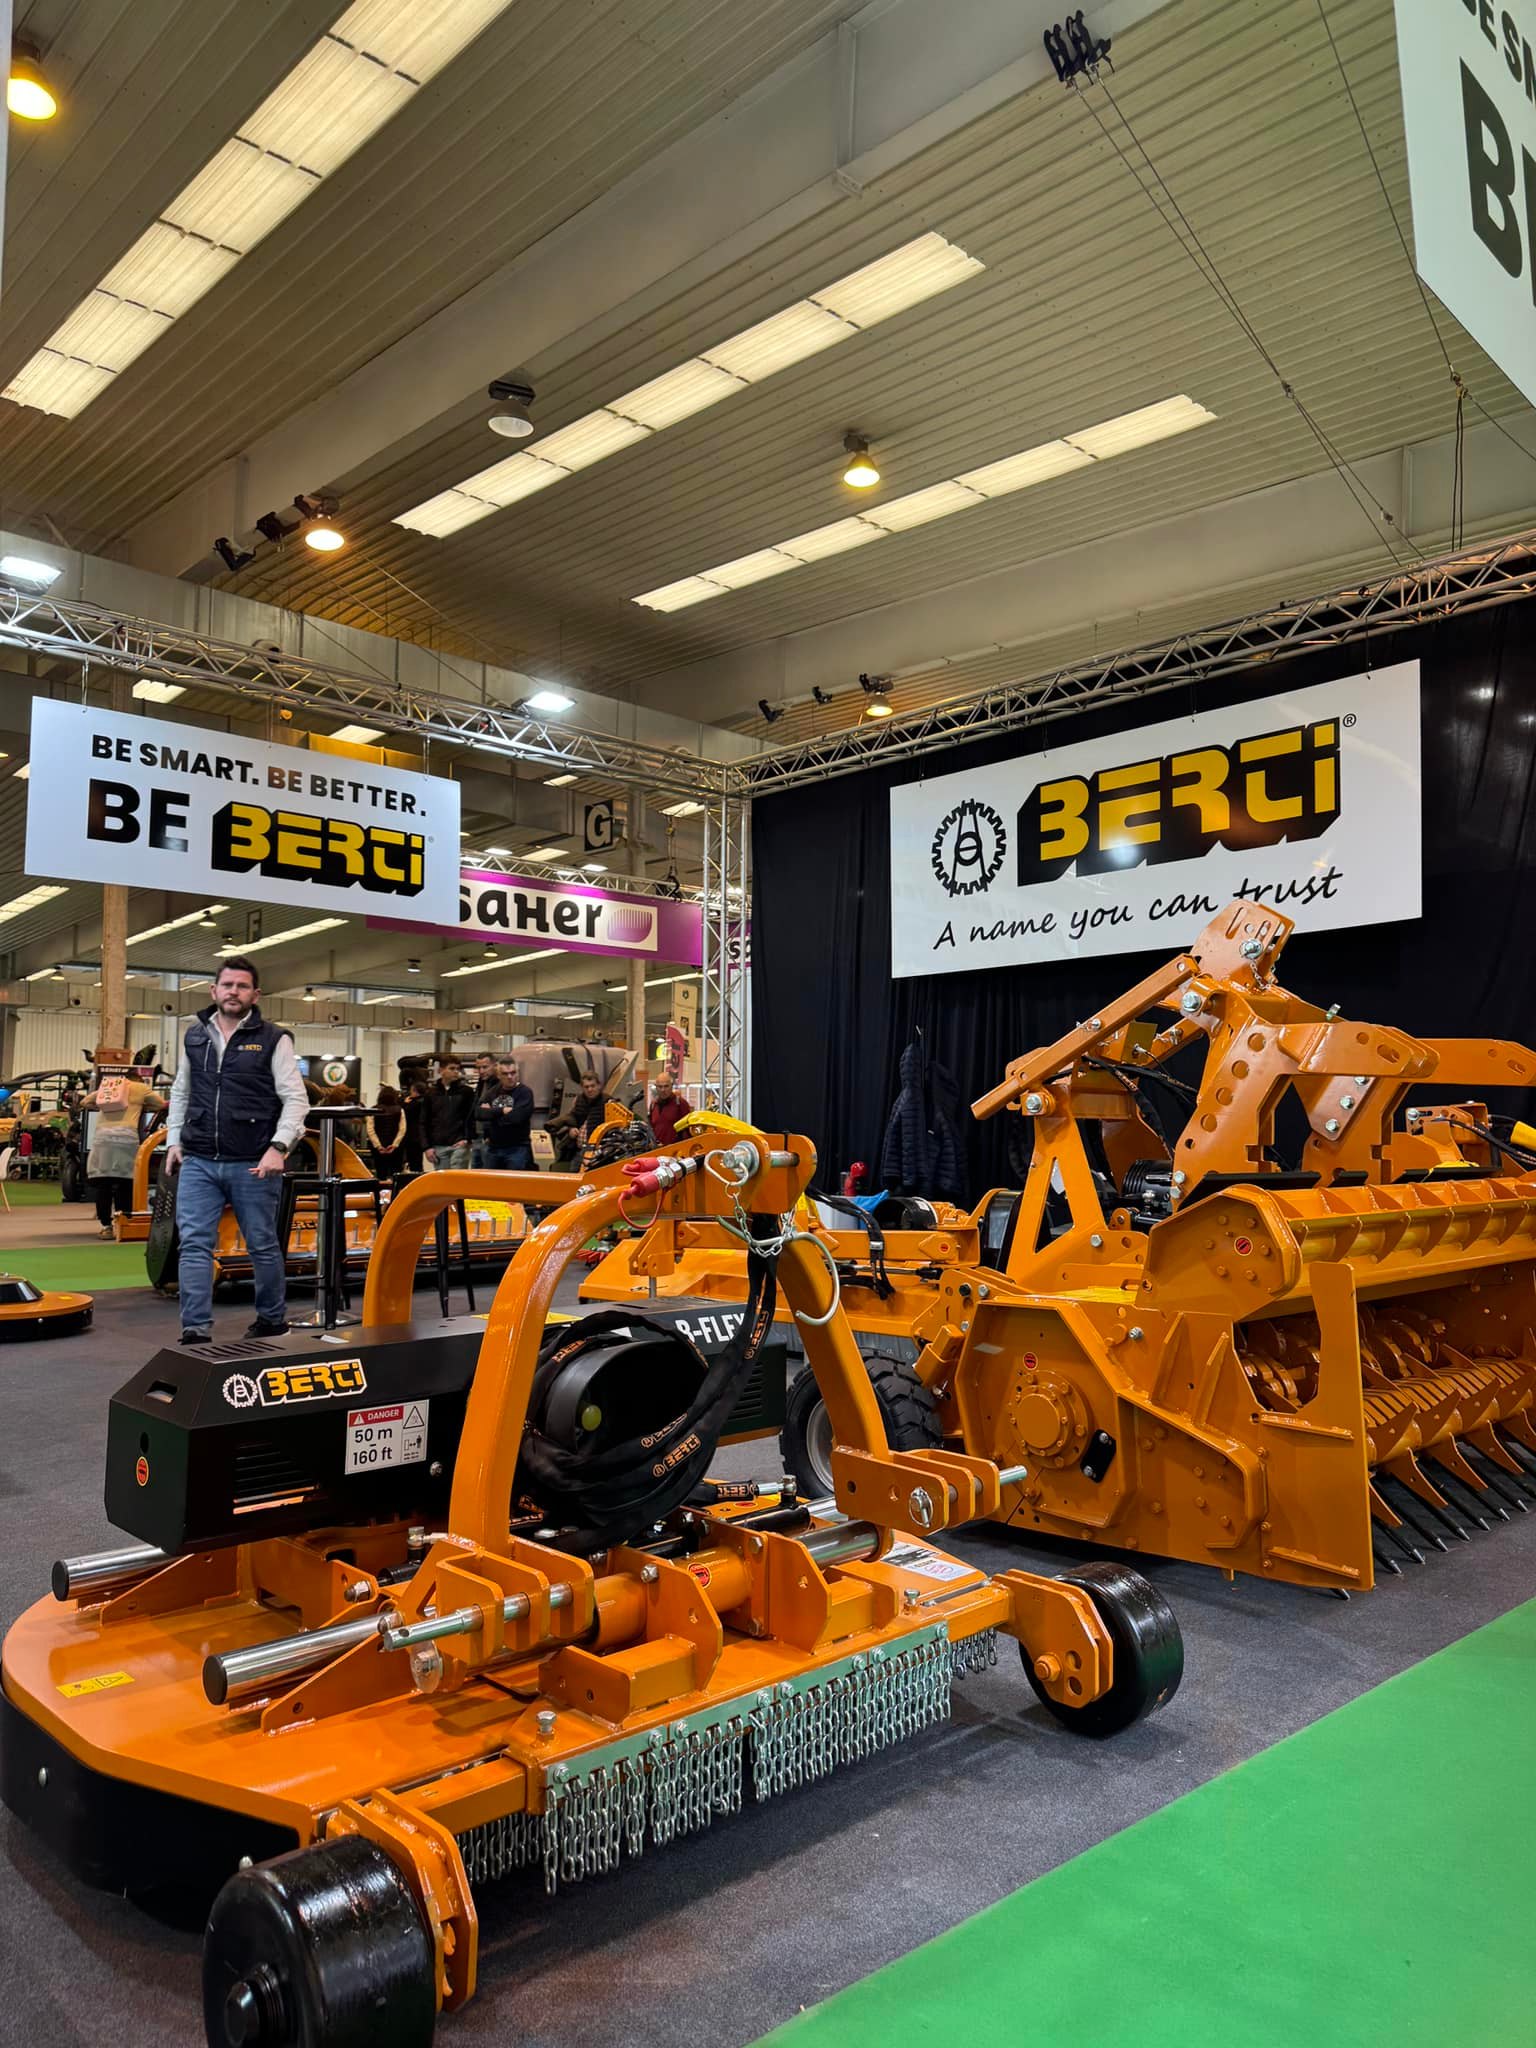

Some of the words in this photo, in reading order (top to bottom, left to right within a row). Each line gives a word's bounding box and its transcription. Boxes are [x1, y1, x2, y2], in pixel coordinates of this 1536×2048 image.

[1460, 56, 1536, 308] B
[92, 735, 132, 763] BE
[140, 743, 259, 785] SMART.
[268, 766, 303, 793] BE
[311, 775, 426, 817] BETTER.
[87, 778, 190, 852] BE
[587, 804, 610, 847] G
[933, 921, 956, 950] A
[970, 913, 1056, 942] name
[1069, 905, 1133, 940] you
[1149, 894, 1218, 920] can
[1233, 867, 1343, 905] trust
[355, 1424, 373, 1443] 50
[378, 1428, 392, 1440] m
[367, 1409, 400, 1421] DANGER
[353, 1449, 377, 1465] 160
[381, 1447, 392, 1460] ft
